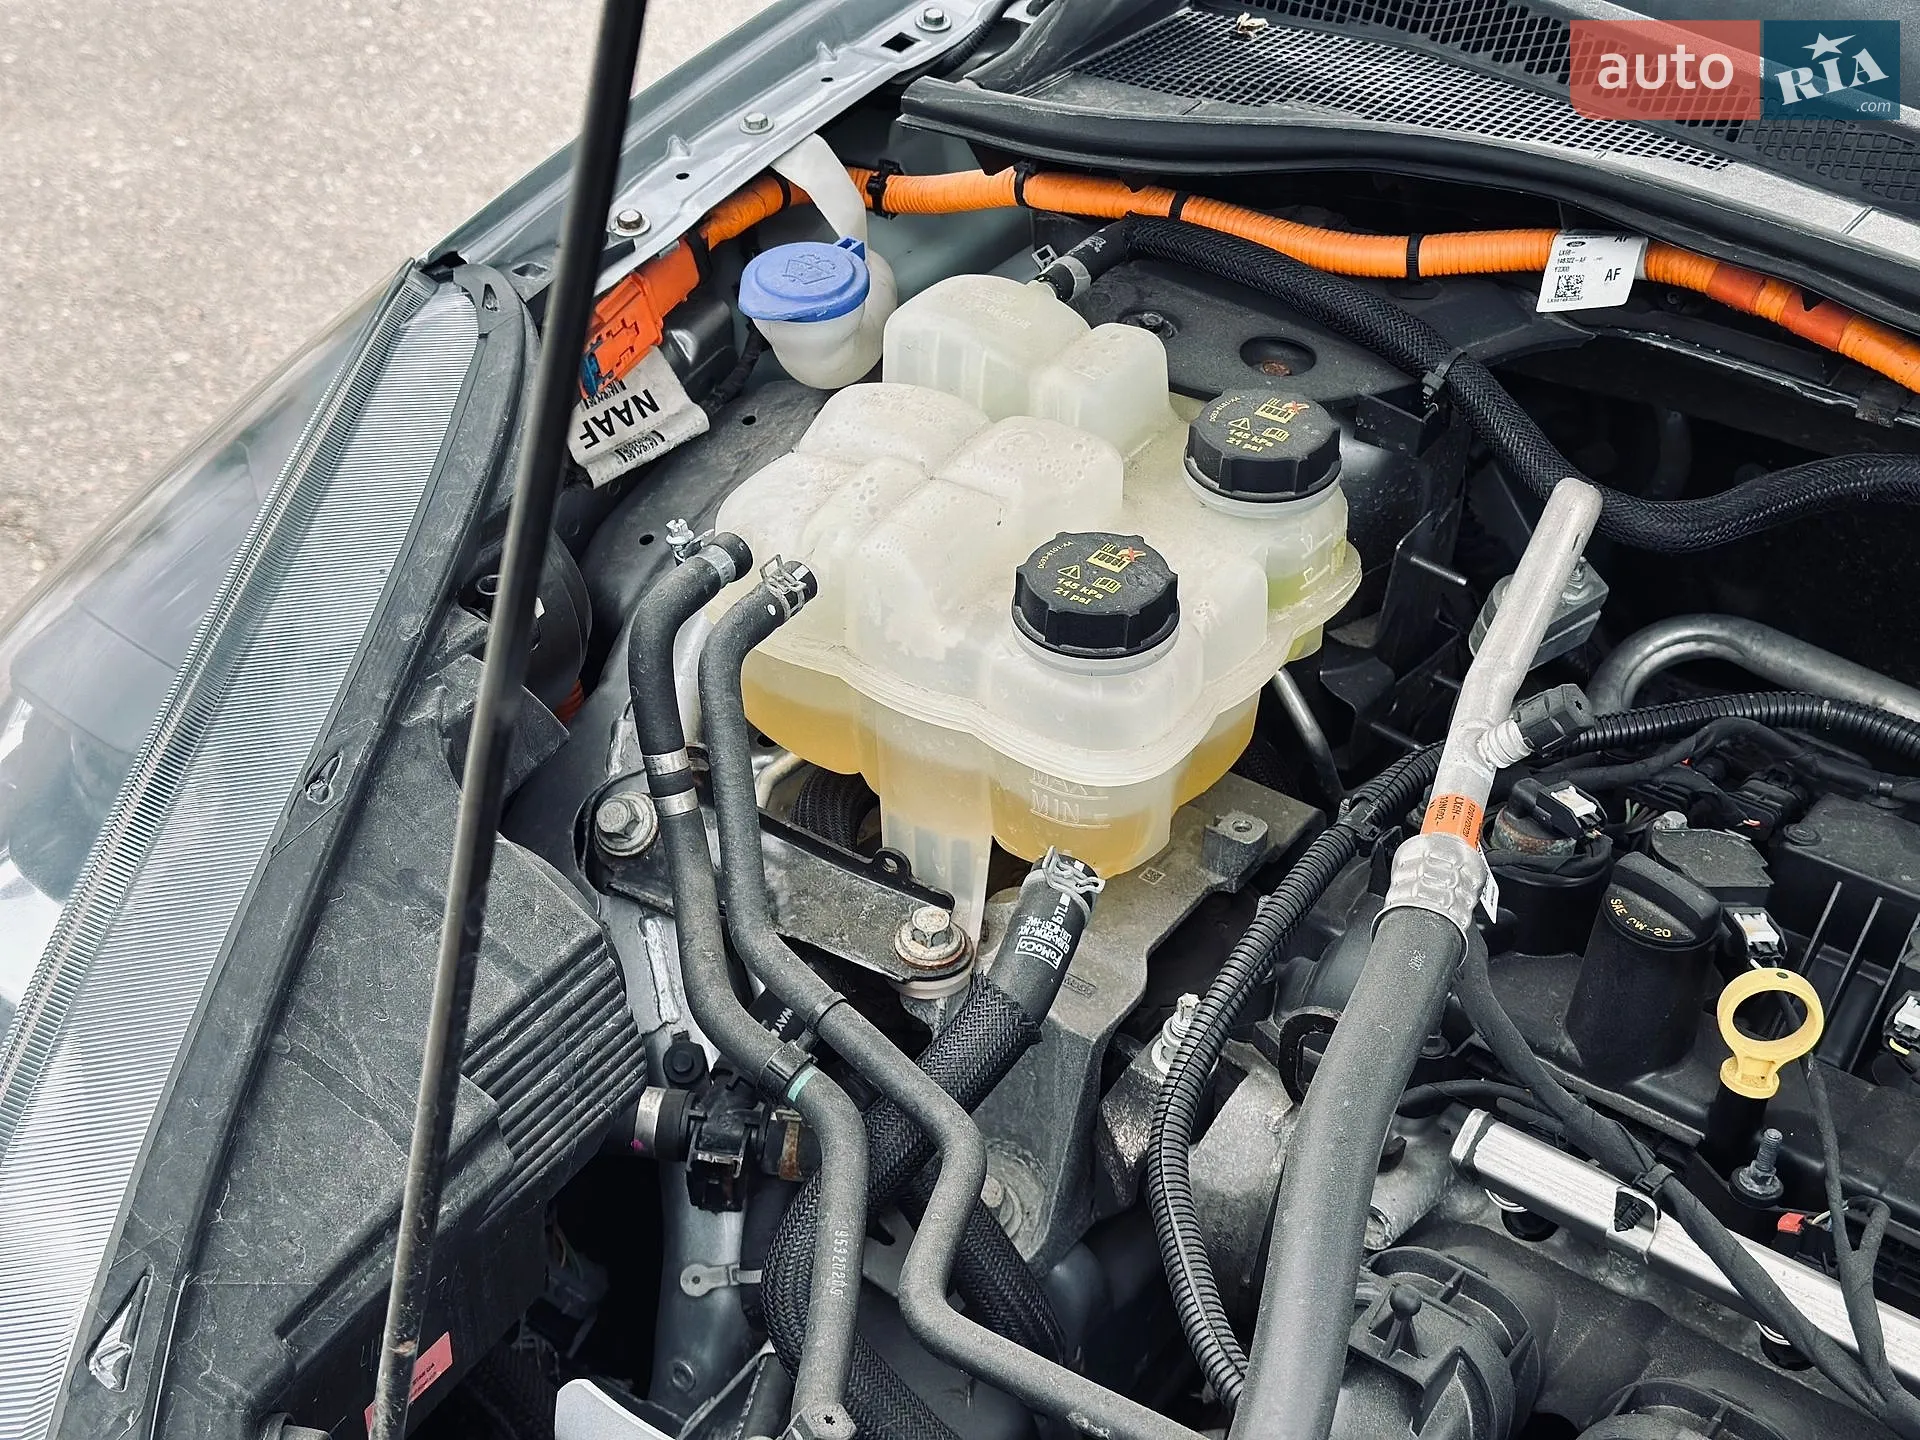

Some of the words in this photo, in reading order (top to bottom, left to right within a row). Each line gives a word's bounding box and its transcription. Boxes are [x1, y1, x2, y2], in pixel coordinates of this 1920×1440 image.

[1604, 267, 1622, 283] AF
[579, 388, 661, 450] NAAF
[1226, 437, 1242, 445] 21
[1242, 443, 1263, 453] psi
[1229, 429, 1251, 439] 145
[1251, 435, 1274, 447] kPa
[1052, 587, 1070, 597] 21
[1070, 594, 1092, 605] psi
[1057, 578, 1080, 590] 145
[1080, 586, 1105, 600] kPa
[1031, 788, 1080, 824] MIN
[1610, 897, 1628, 917] SAE
